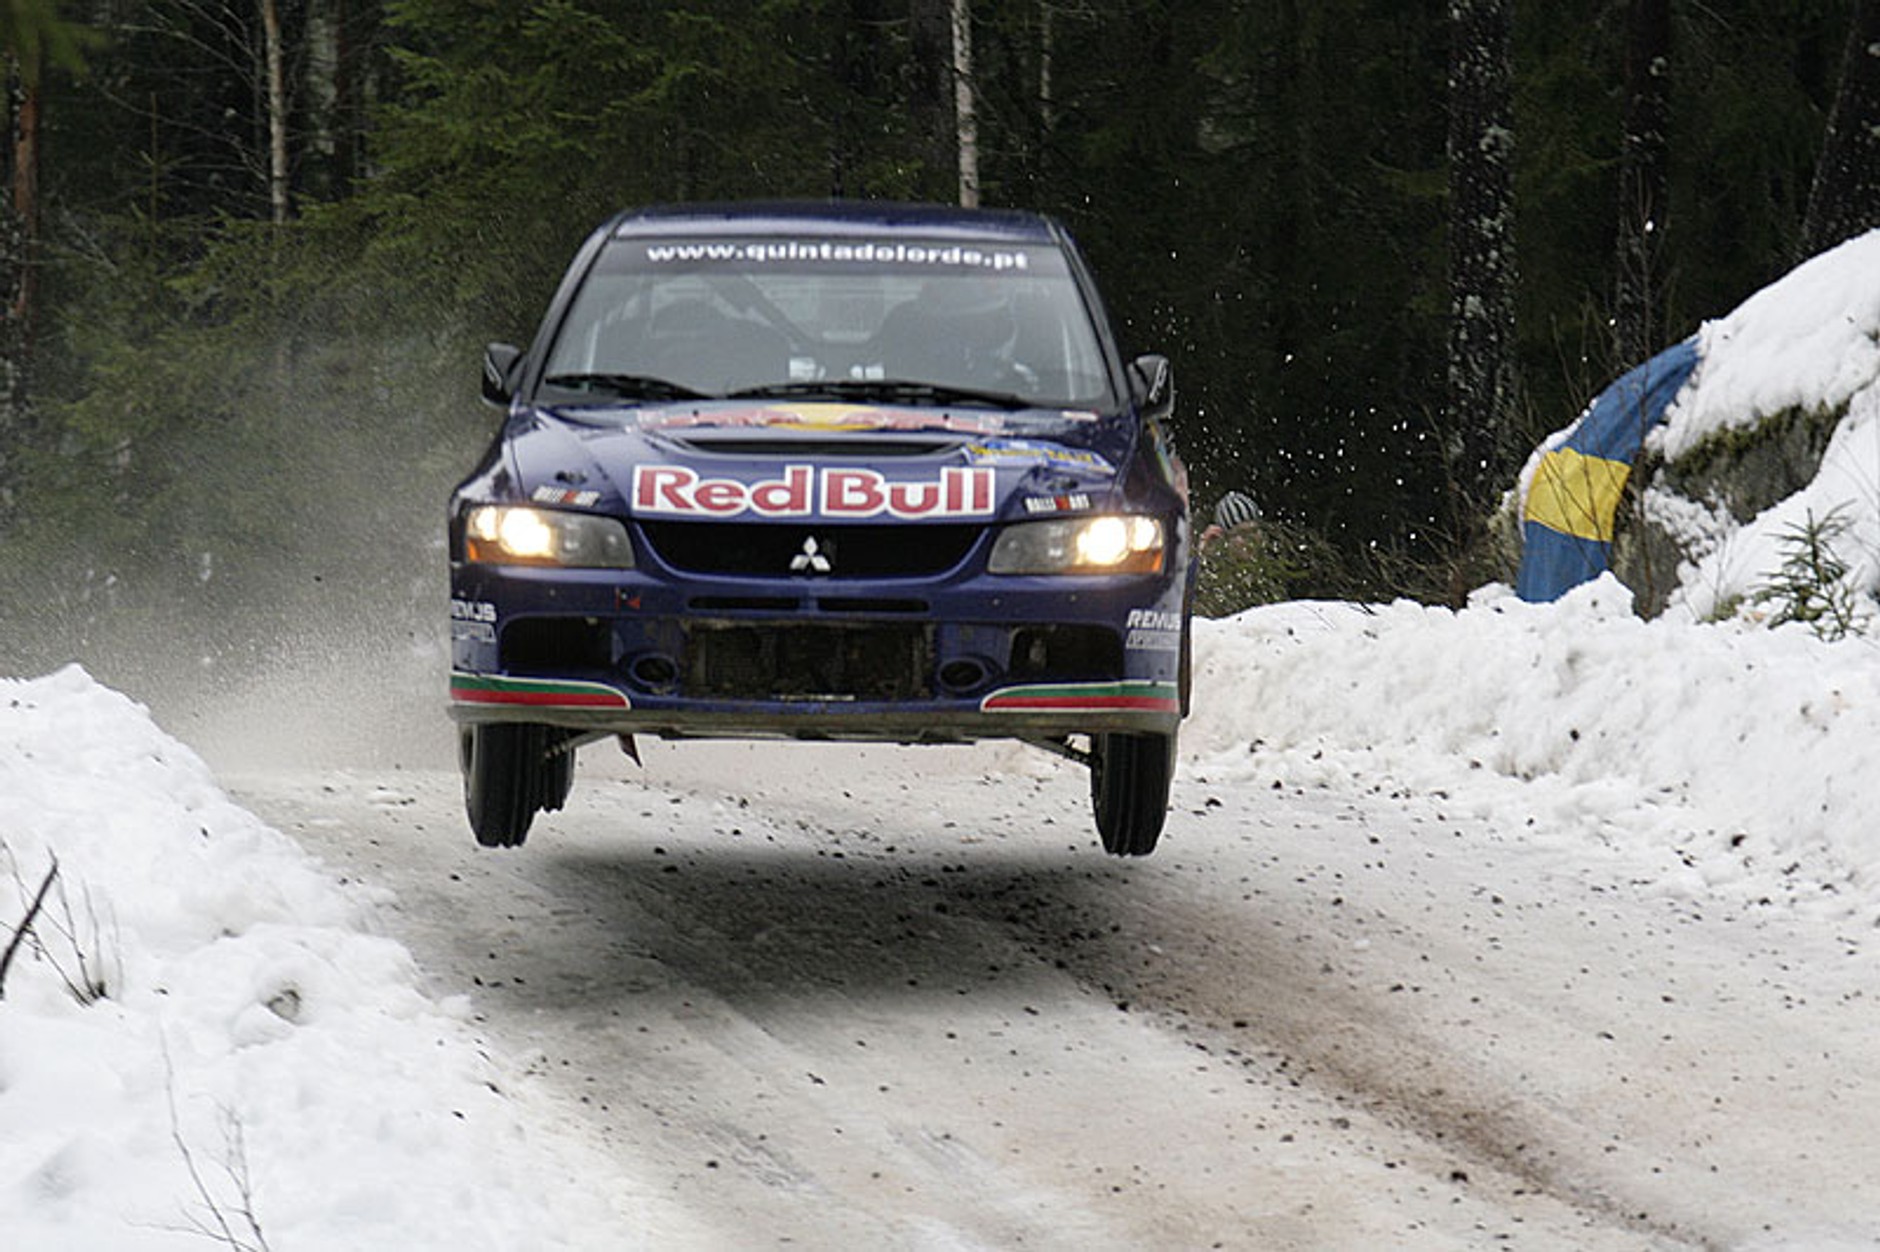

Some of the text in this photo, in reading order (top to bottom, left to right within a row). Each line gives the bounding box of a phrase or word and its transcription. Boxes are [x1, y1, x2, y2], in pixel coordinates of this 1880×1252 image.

[646, 243, 1029, 269] www.quintadolorde.pt
[634, 465, 995, 518] Red Bull
